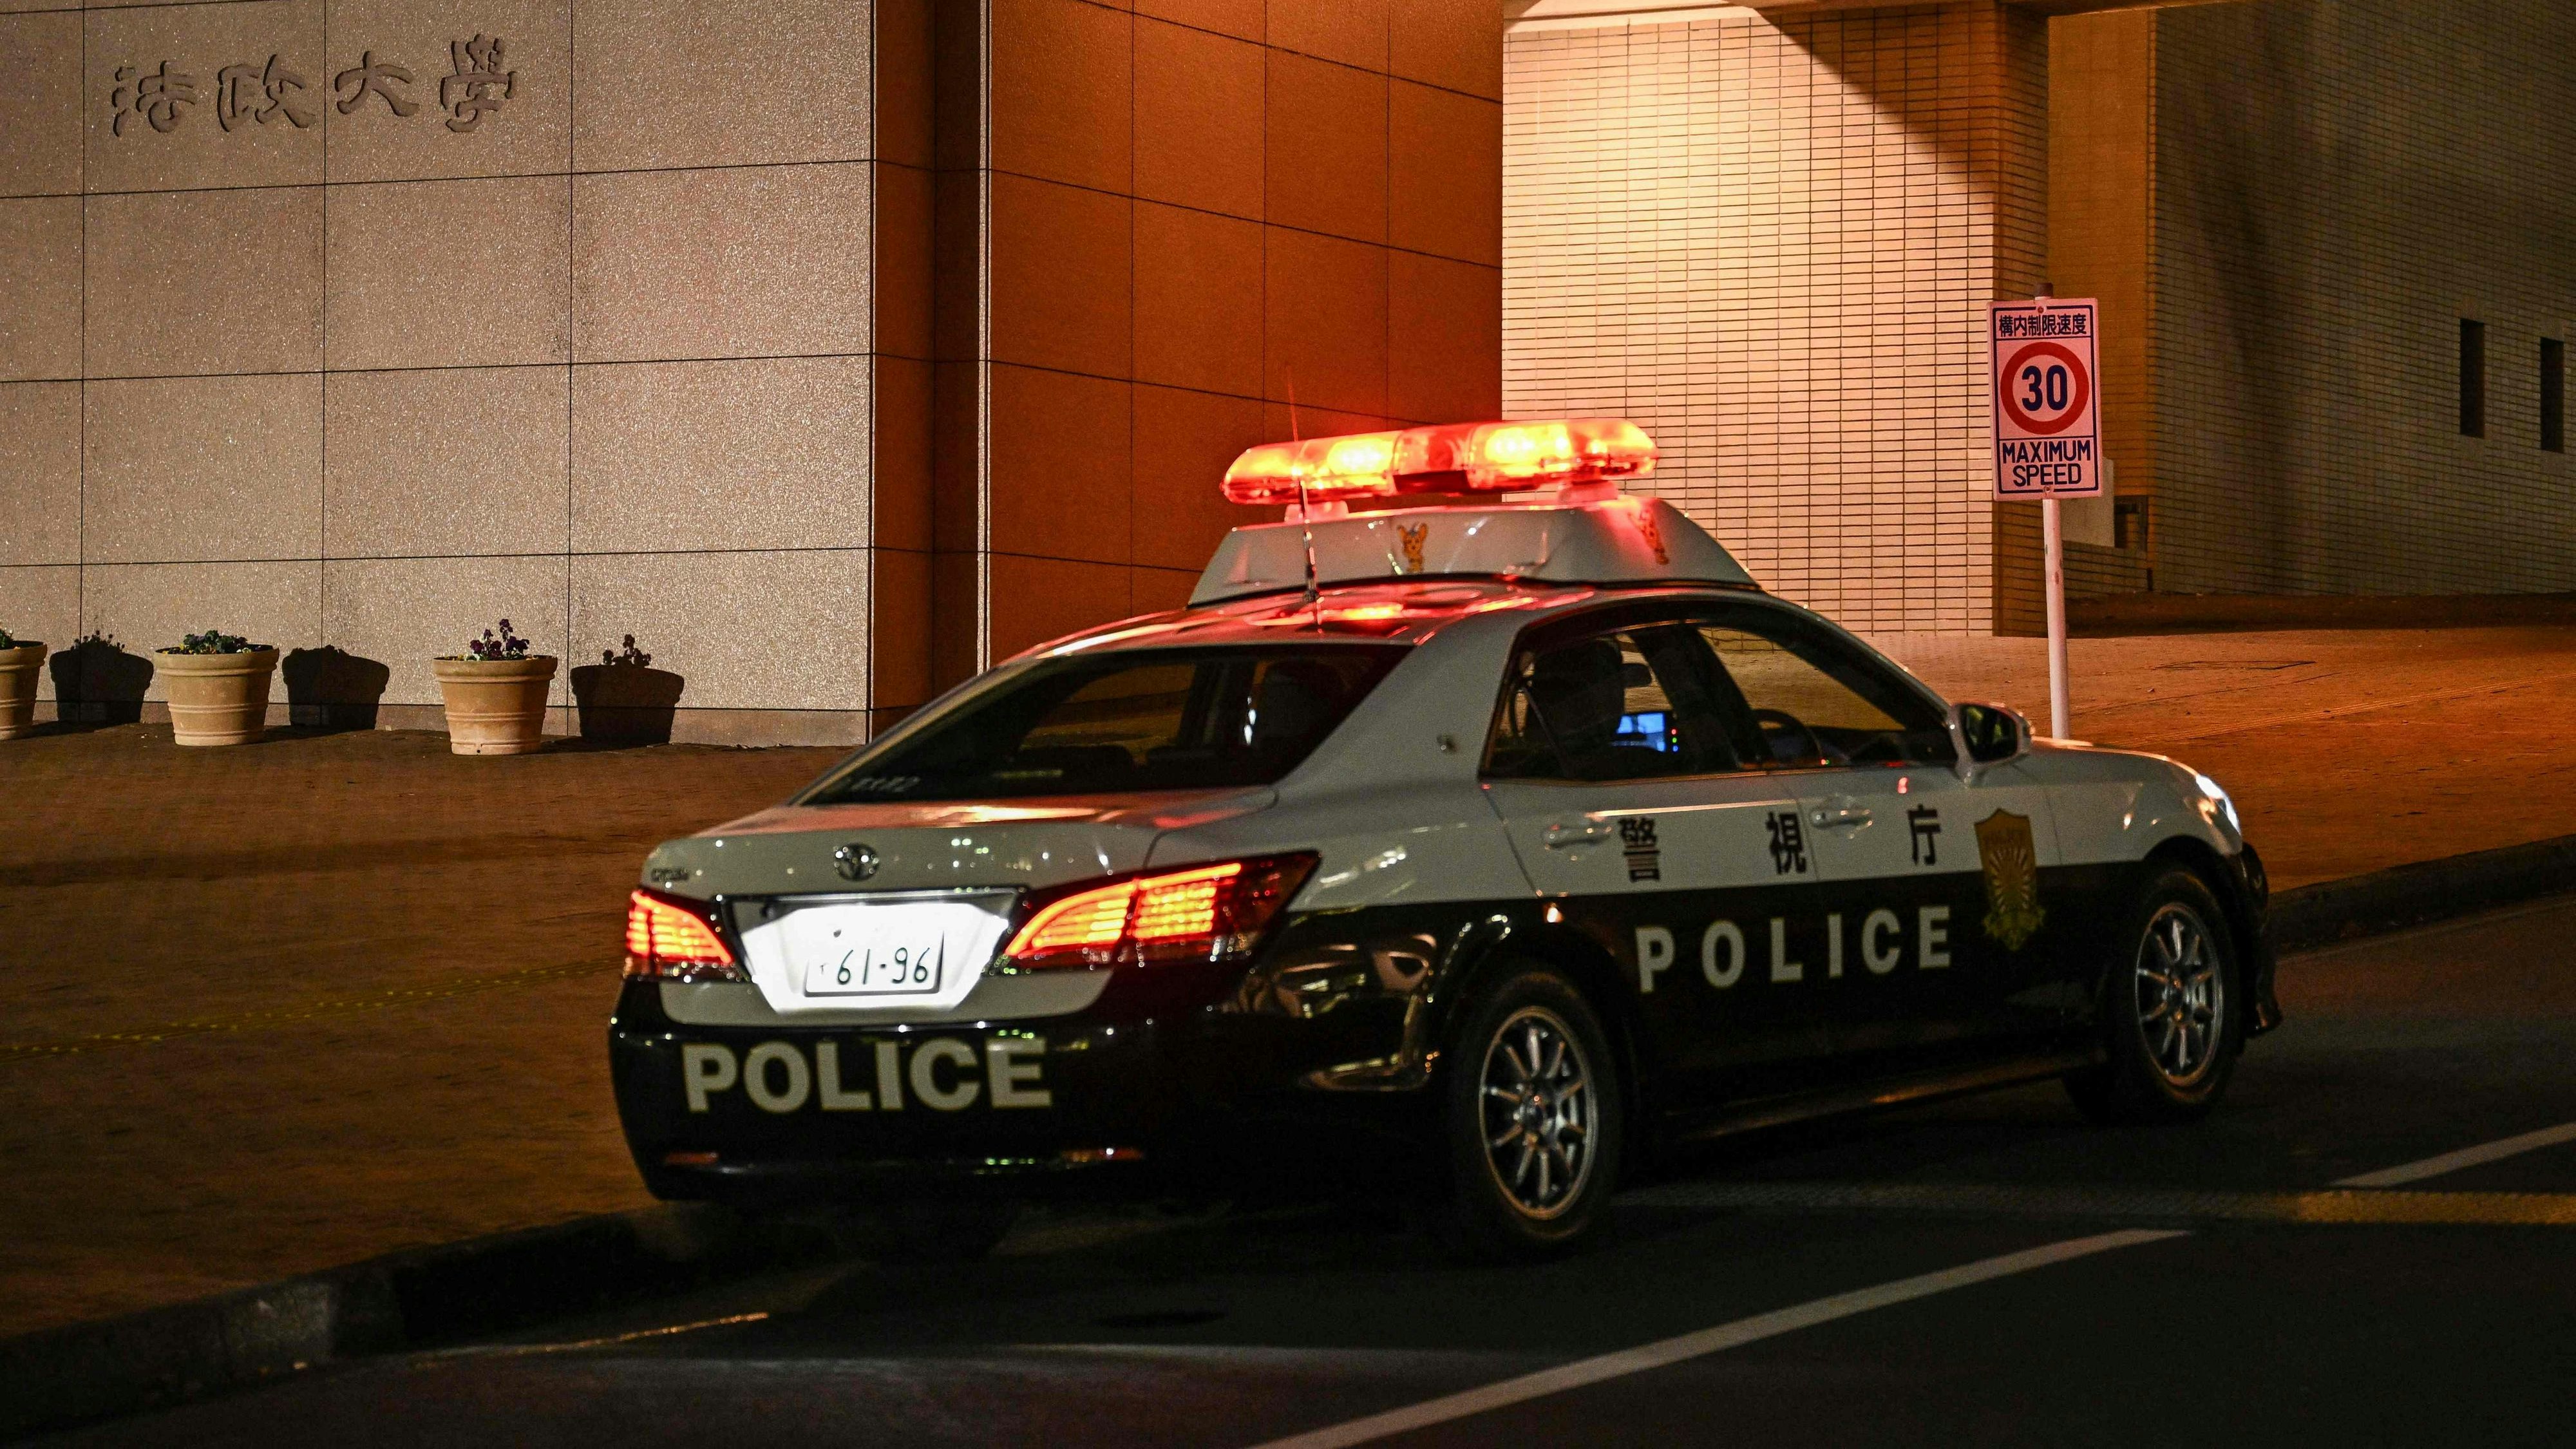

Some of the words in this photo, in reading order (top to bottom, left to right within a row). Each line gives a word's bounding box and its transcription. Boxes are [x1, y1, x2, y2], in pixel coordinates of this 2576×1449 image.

[1999, 313, 2087, 337] 構内制限速度
[2022, 365, 2068, 412] 30
[2002, 440, 2091, 464] MAXIMUM
[2012, 463, 2082, 488] SPEED
[1618, 804, 1941, 882] 警視庁
[837, 947, 930, 985] 61-96
[1635, 905, 1952, 994] POLICE
[681, 1037, 1053, 1113] POLICE
